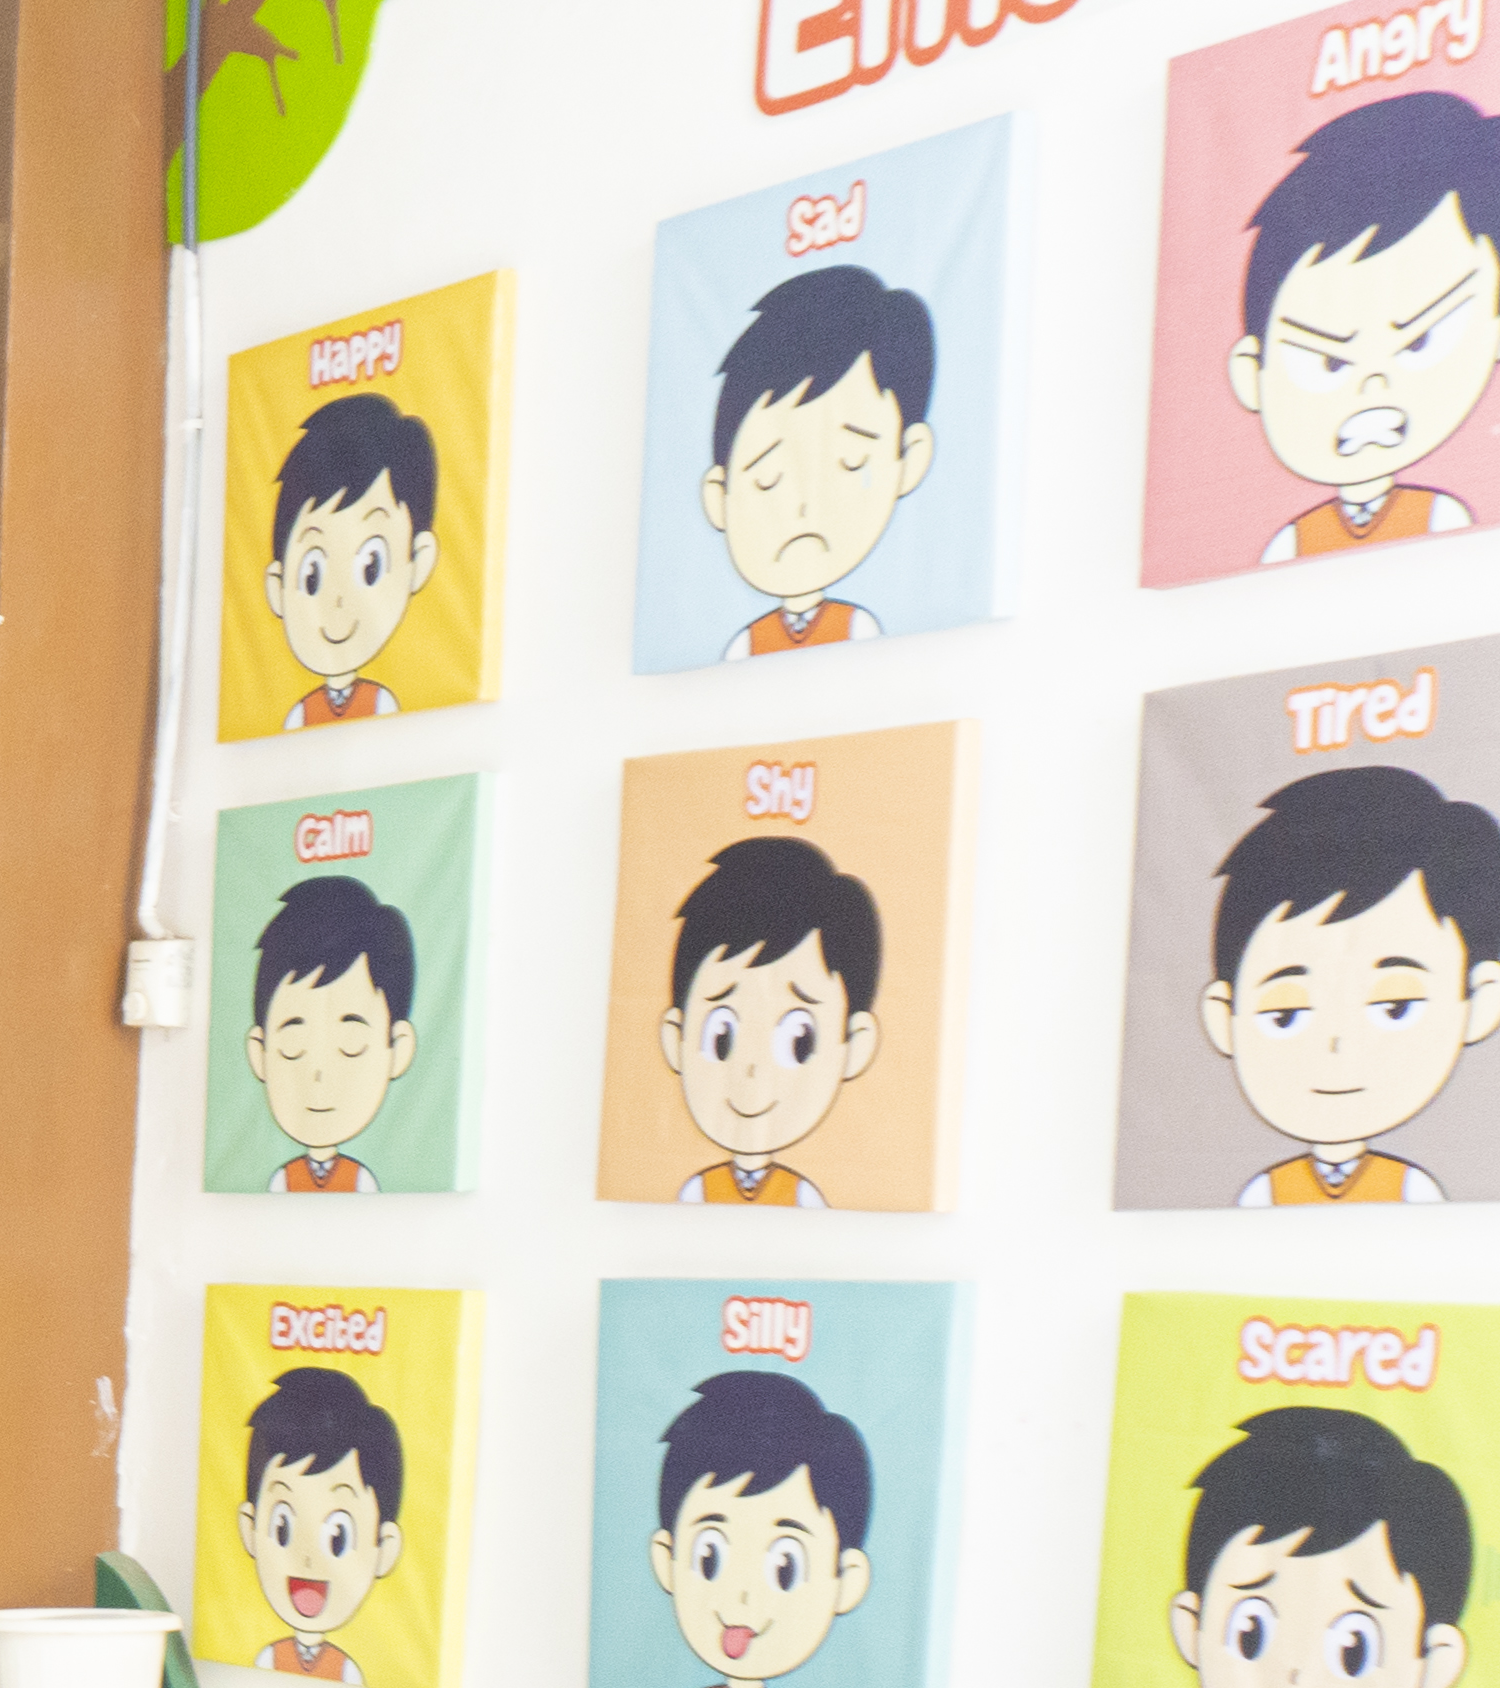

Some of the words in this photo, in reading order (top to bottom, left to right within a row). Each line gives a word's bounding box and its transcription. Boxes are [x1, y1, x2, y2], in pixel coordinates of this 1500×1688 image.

[1307, 0, 1483, 98] Angry
[786, 179, 867, 257] Sad
[309, 318, 404, 389] Happy
[1285, 666, 1439, 755] Tired
[745, 759, 816, 824] Shy
[295, 809, 373, 864] Calm
[269, 1300, 387, 1356] Excited
[721, 1296, 811, 1362] Silly
[1237, 1315, 1441, 1393] Scared
